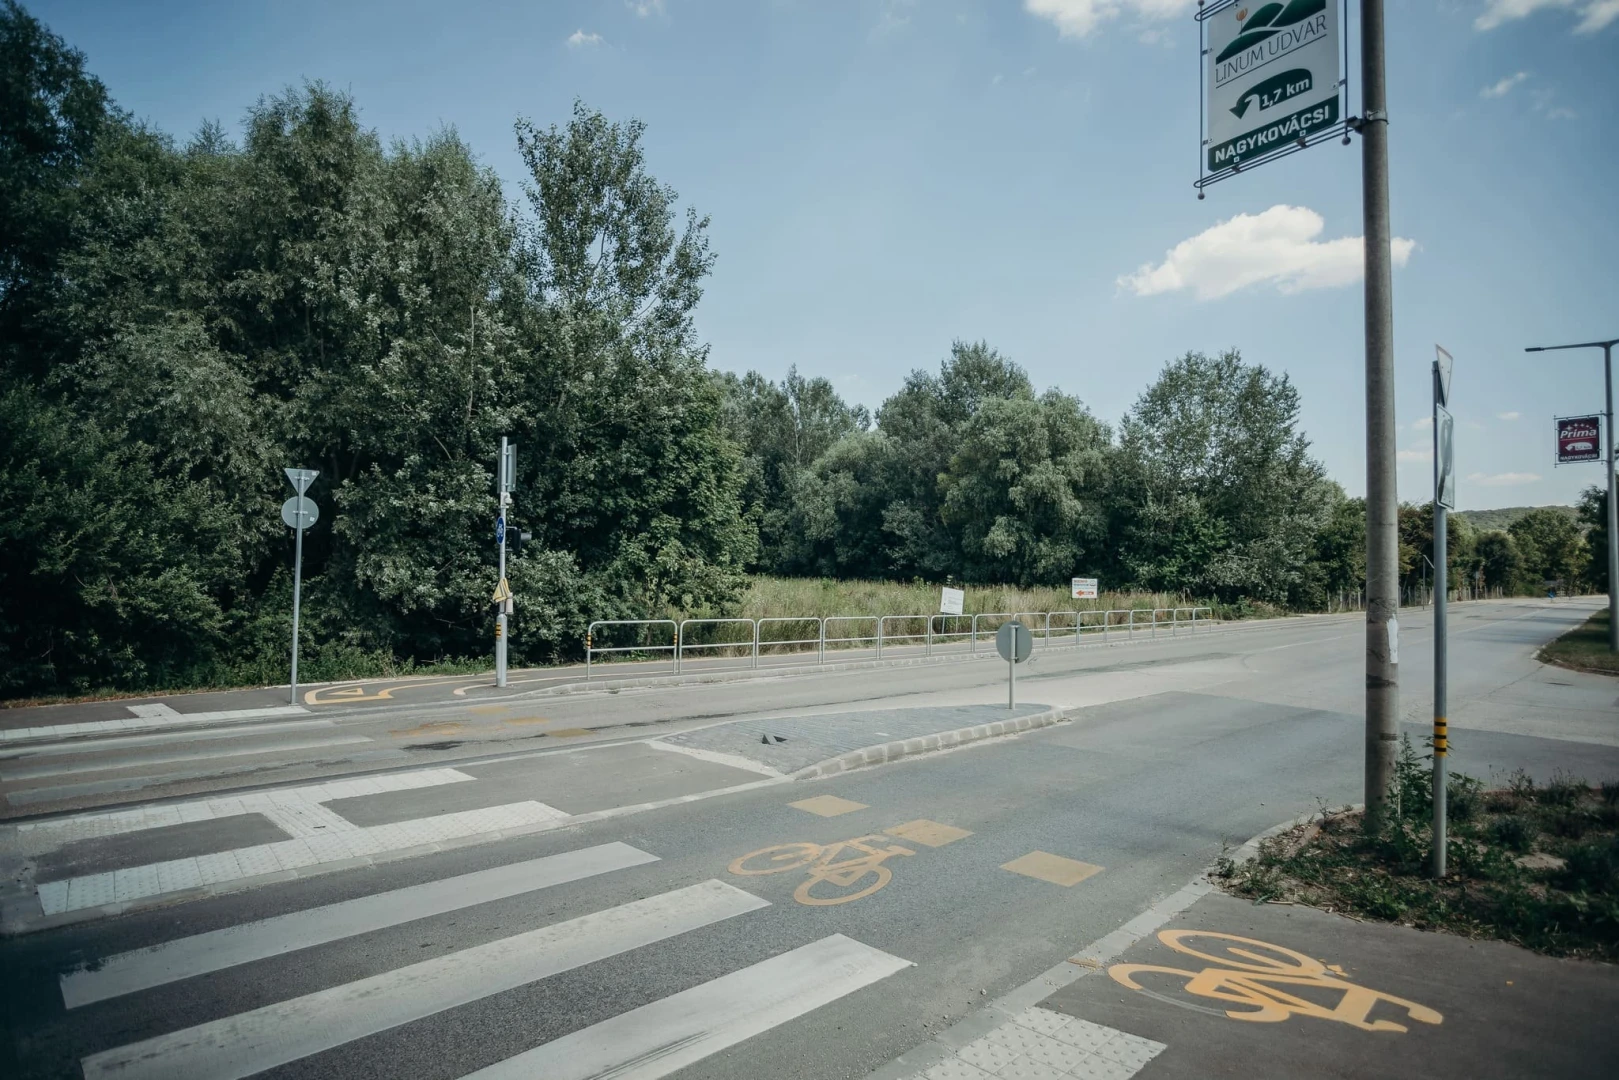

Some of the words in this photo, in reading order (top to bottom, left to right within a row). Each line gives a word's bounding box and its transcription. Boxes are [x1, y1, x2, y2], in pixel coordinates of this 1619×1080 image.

[1216, 46, 1264, 83] LINUM
[1268, 14, 1327, 55] UDVAR
[1262, 90, 1282, 108] 1,7
[1286, 78, 1310, 97] km
[1215, 105, 1329, 163] NAGYKOVÁCSI
[1560, 429, 1597, 439] Prima
